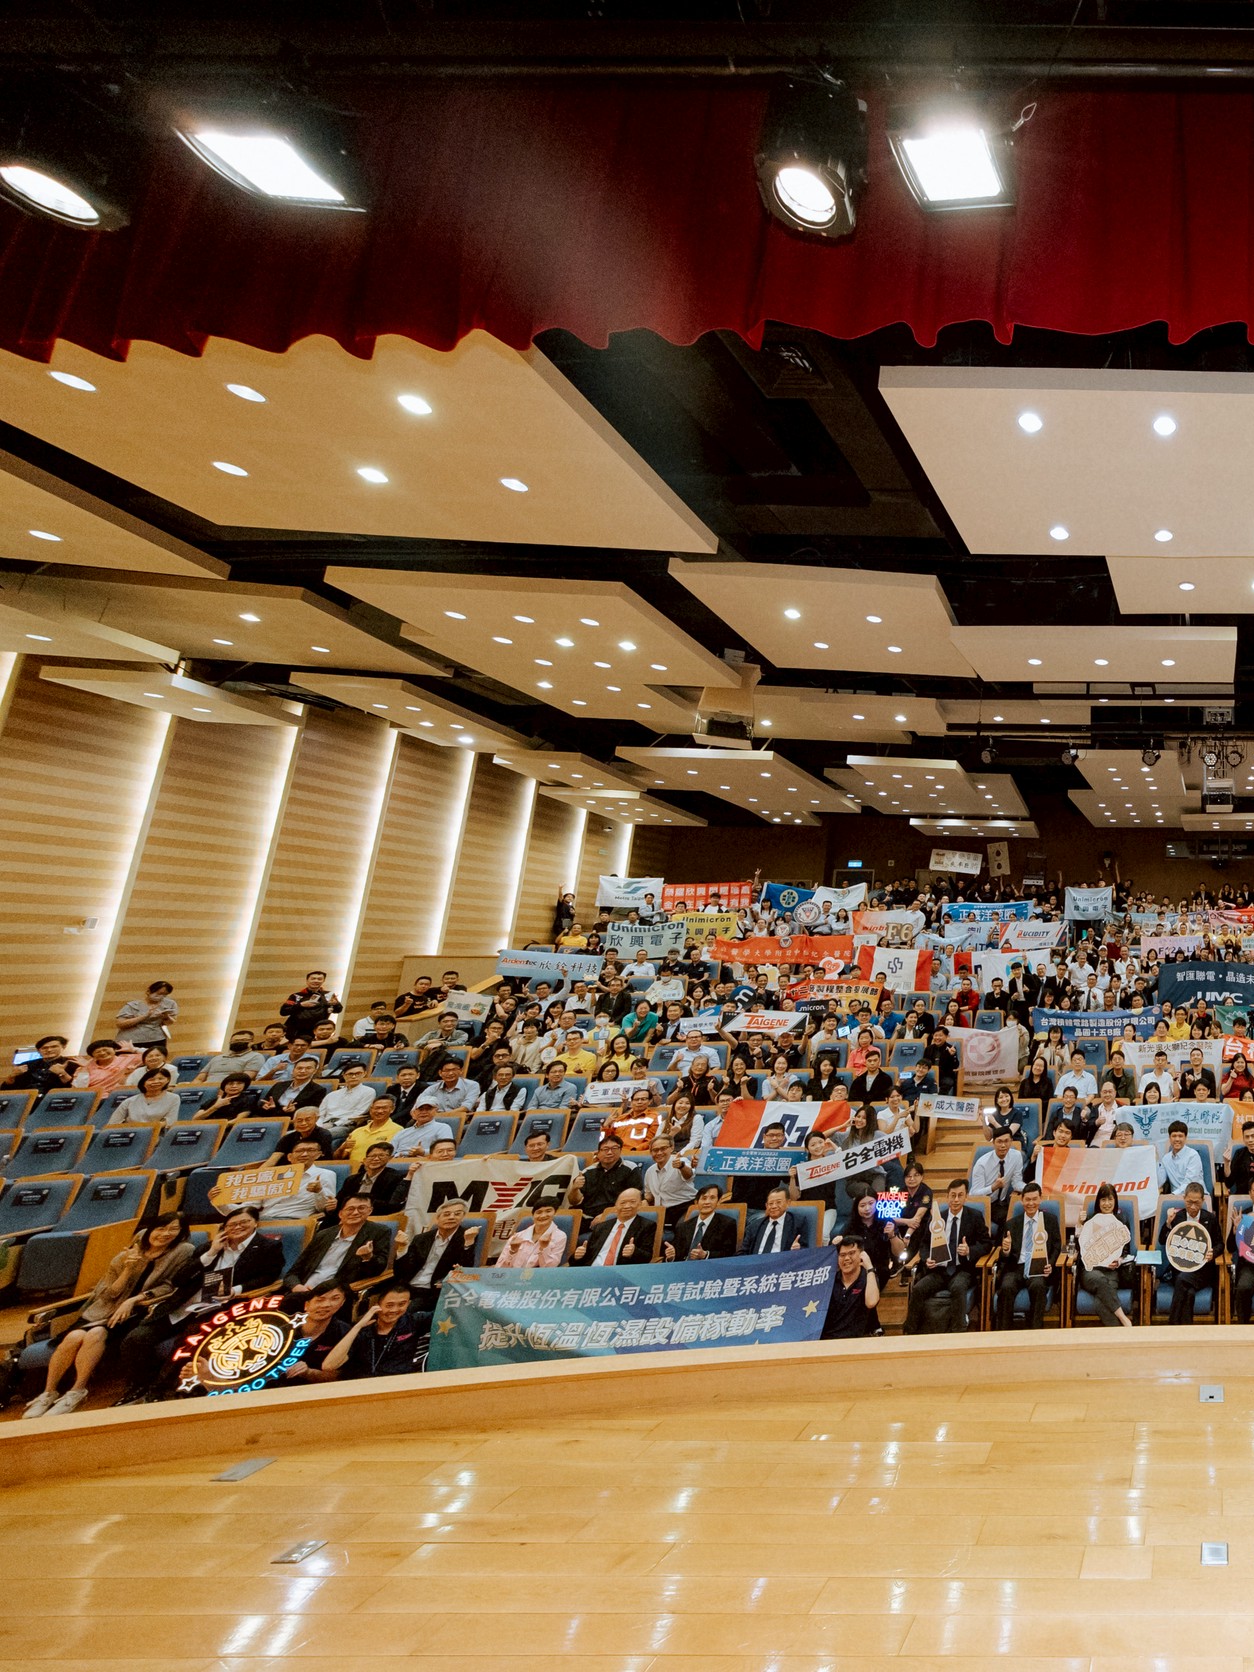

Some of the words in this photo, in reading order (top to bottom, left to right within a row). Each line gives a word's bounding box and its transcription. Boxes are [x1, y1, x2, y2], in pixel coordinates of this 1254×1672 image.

[611, 921, 685, 934] Unimicron
[609, 931, 684, 948] 欣興電子
[501, 956, 538, 966] Ardentec
[1196, 991, 1244, 1003] UMC
[799, 1004, 826, 1012] micron
[744, 1014, 790, 1030] TAIGENE
[934, 1100, 975, 1113] 成大醫院
[1181, 1108, 1224, 1125] 奇美醫院
[842, 1135, 905, 1170] 台全電機
[805, 1160, 841, 1180] TAIGENE
[427, 1174, 572, 1213] MXIC
[1062, 1176, 1151, 1195] winond
[876, 1191, 909, 1202] TAIGENE
[876, 1201, 901, 1211] GOGO
[877, 1208, 902, 1219] TIGER
[172, 1294, 285, 1362] TAIGENE
[265, 1337, 313, 1381] TIGER
